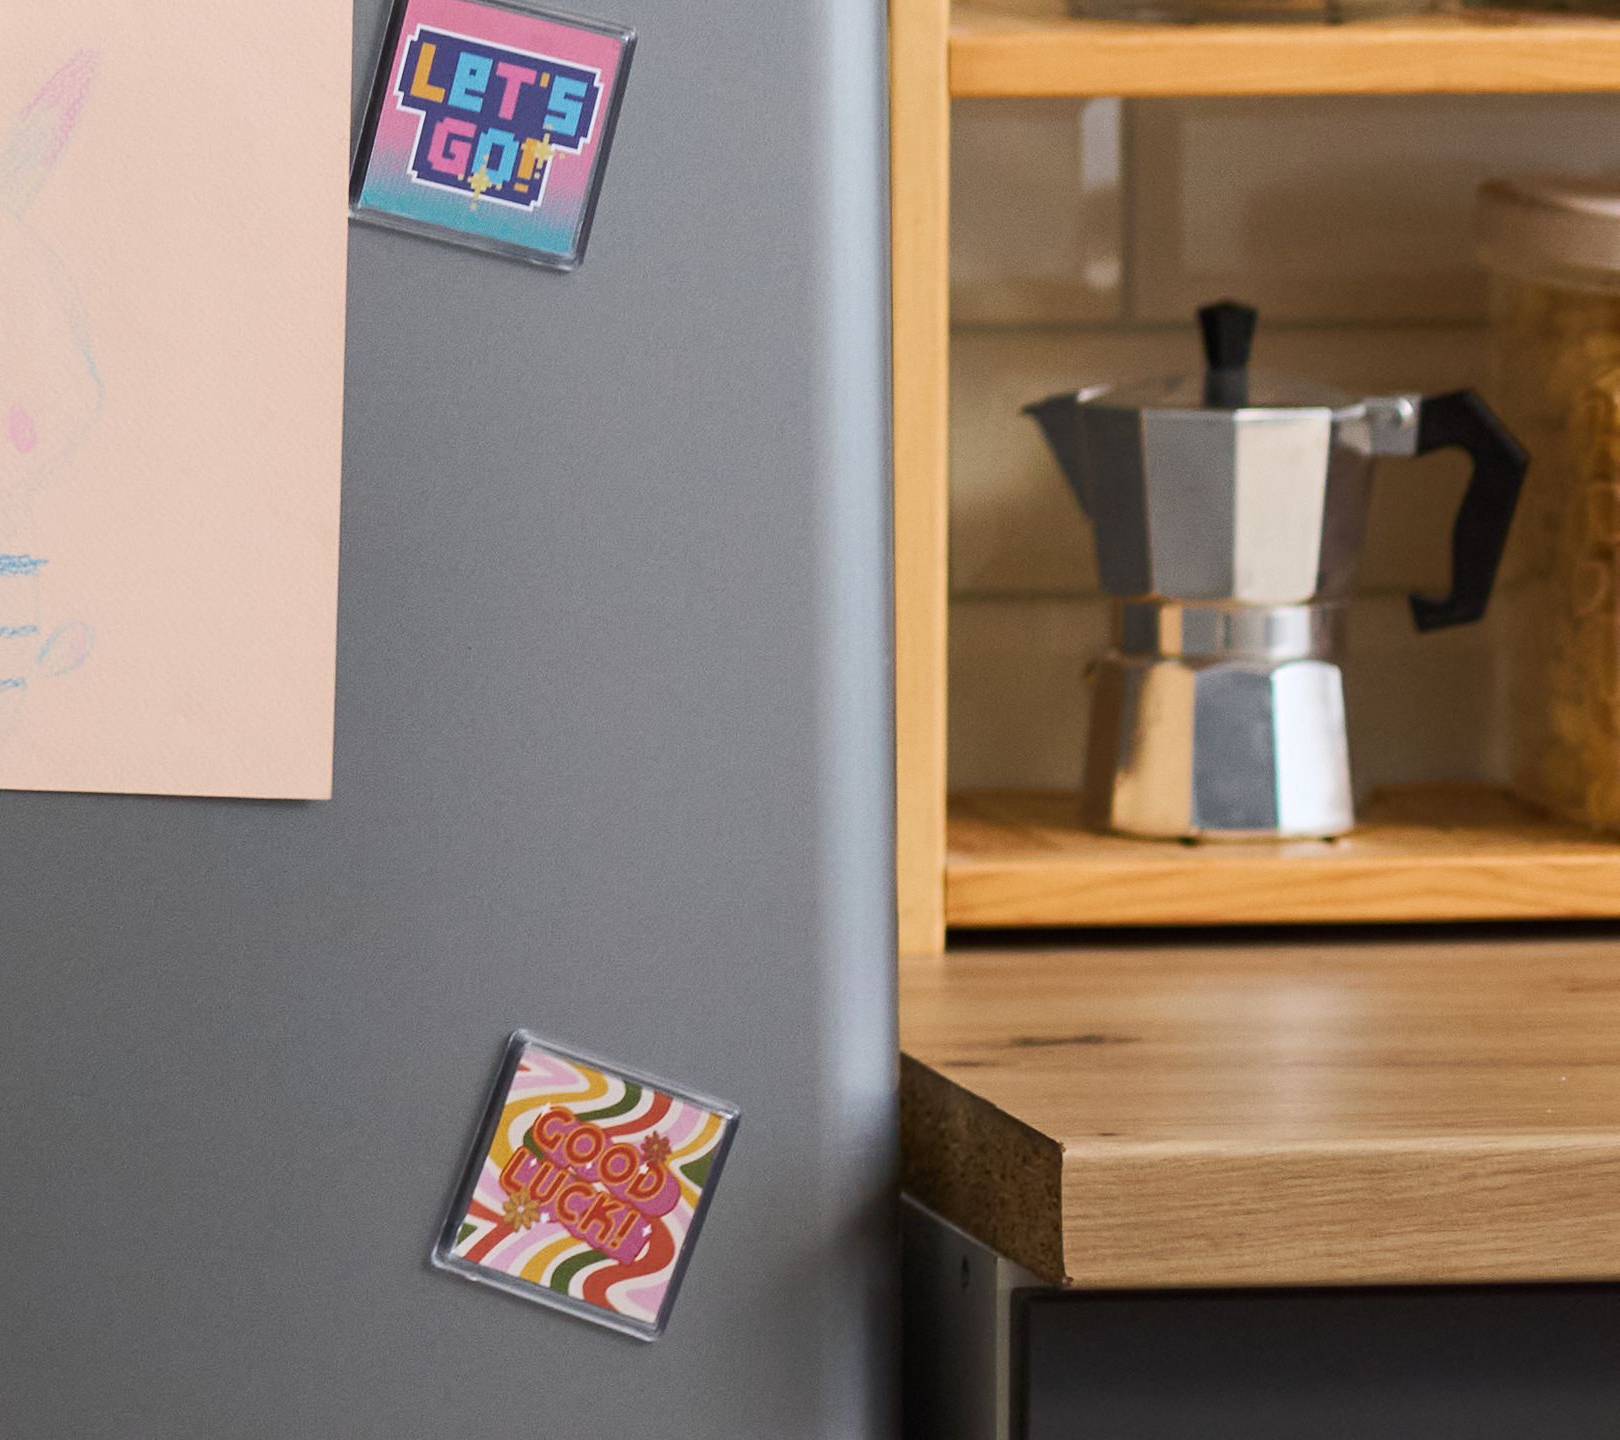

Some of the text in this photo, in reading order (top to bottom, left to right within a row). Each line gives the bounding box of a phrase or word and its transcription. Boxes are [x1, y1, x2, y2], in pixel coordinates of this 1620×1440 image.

[410, 42, 589, 137] LET'S
[428, 117, 540, 193] GO!
[500, 1146, 640, 1250] LUCK!
[532, 1106, 667, 1201] GOOD
